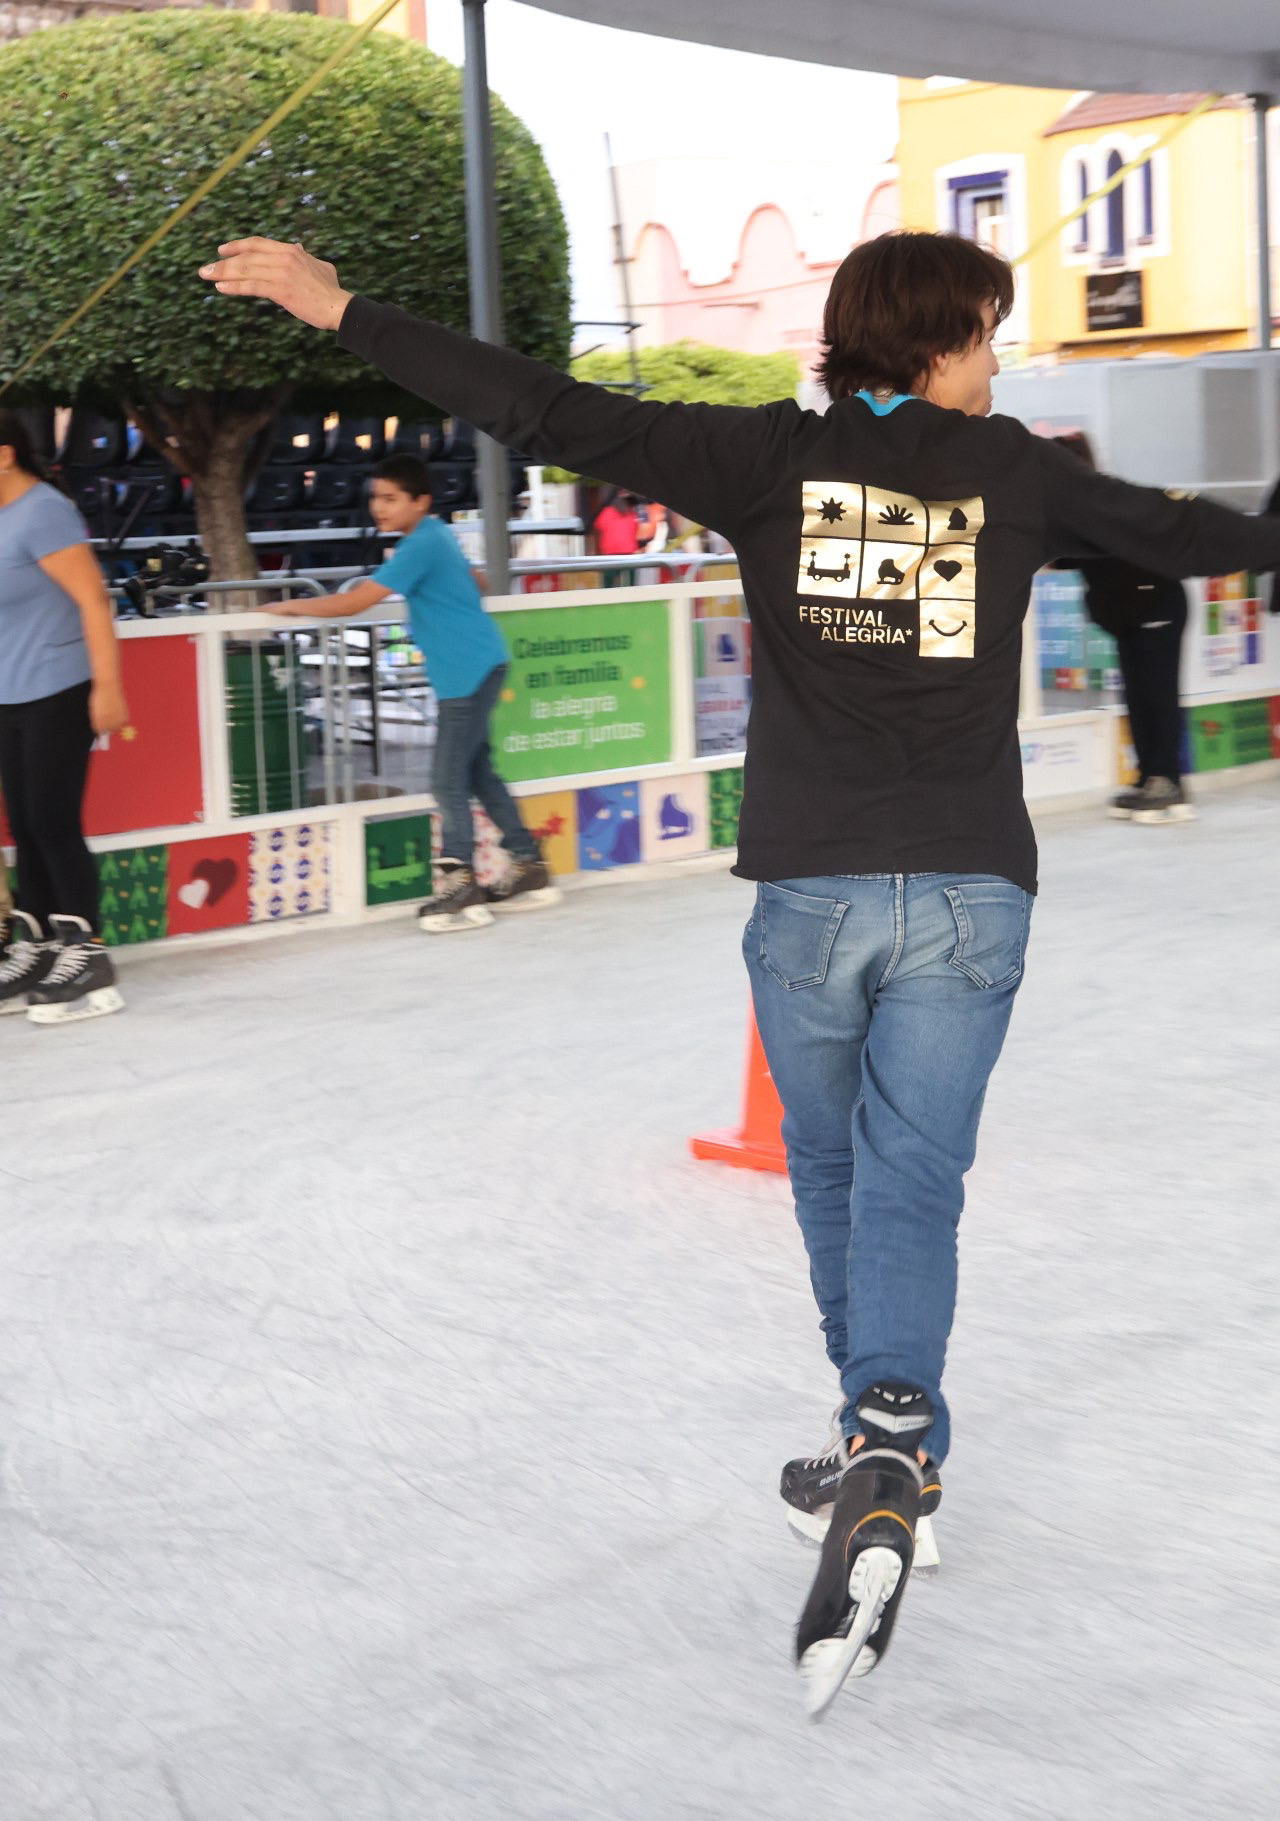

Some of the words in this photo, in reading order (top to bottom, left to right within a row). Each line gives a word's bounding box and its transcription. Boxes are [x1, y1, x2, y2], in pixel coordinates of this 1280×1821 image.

[799, 605, 888, 627] FESTIVAL
[513, 635, 633, 660] Celebremos
[554, 661, 622, 686] familia
[531, 698, 551, 719] la
[503, 731, 530, 752] de
[531, 728, 582, 750] estar
[583, 721, 646, 750] juntos
